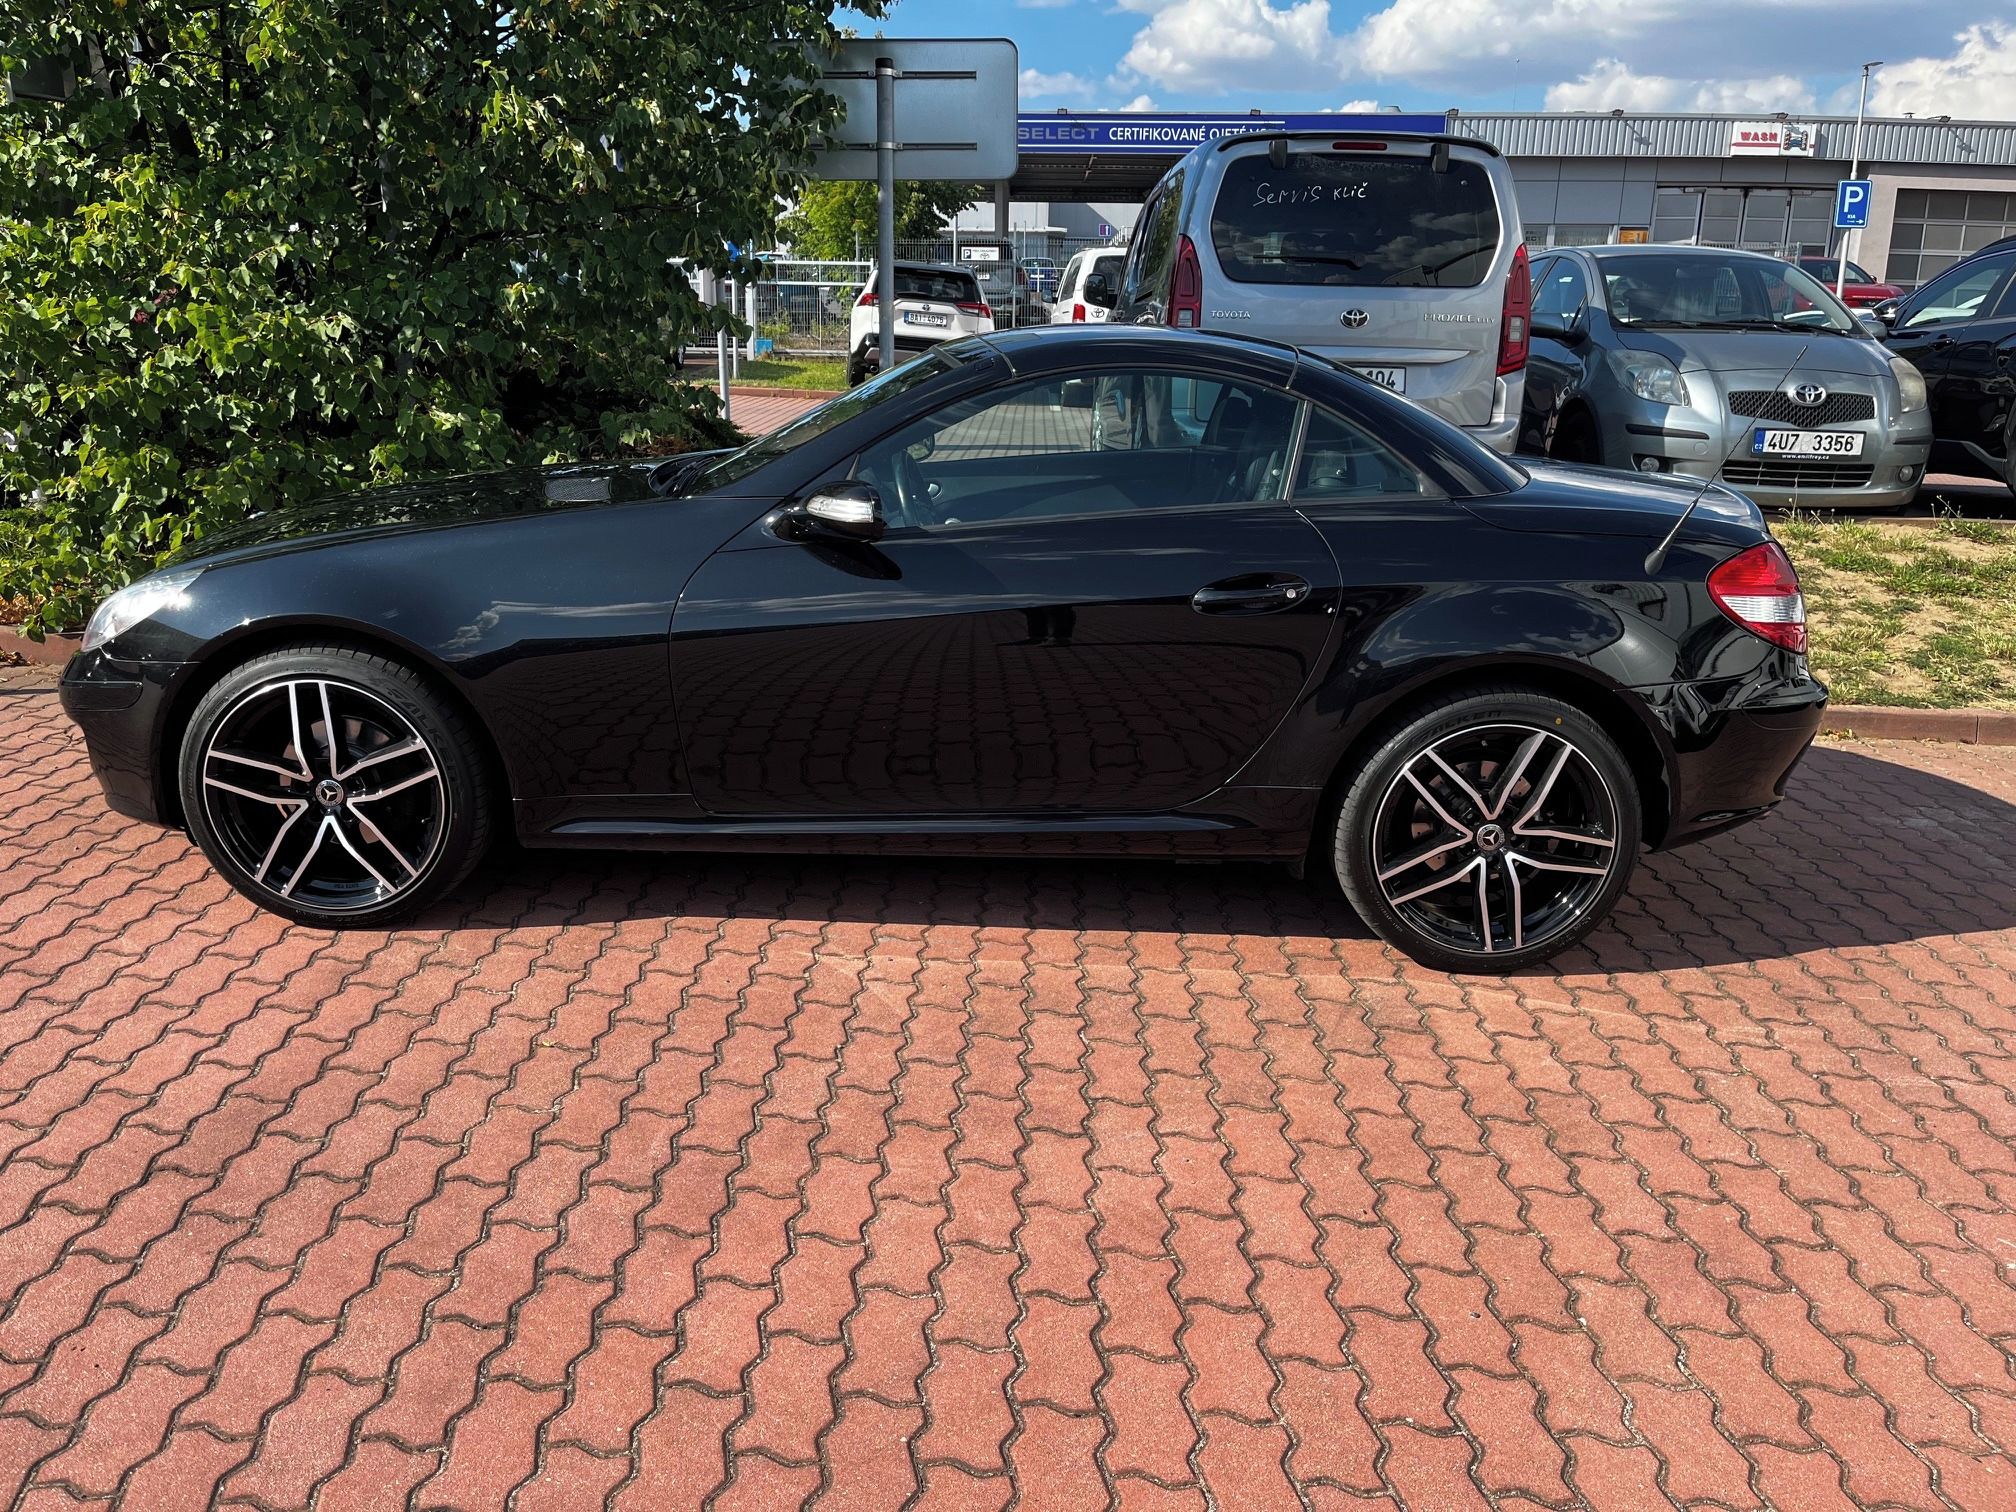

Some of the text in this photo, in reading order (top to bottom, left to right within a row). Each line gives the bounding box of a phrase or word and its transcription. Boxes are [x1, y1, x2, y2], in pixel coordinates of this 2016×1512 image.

[1018, 127, 1099, 140] SELECT
[1109, 125, 1206, 141] CERTIFIKOVANÉ
[1843, 186, 1864, 213] P
[1210, 310, 1251, 319] TOYOTA
[1768, 432, 1855, 452] 4U7 3356
